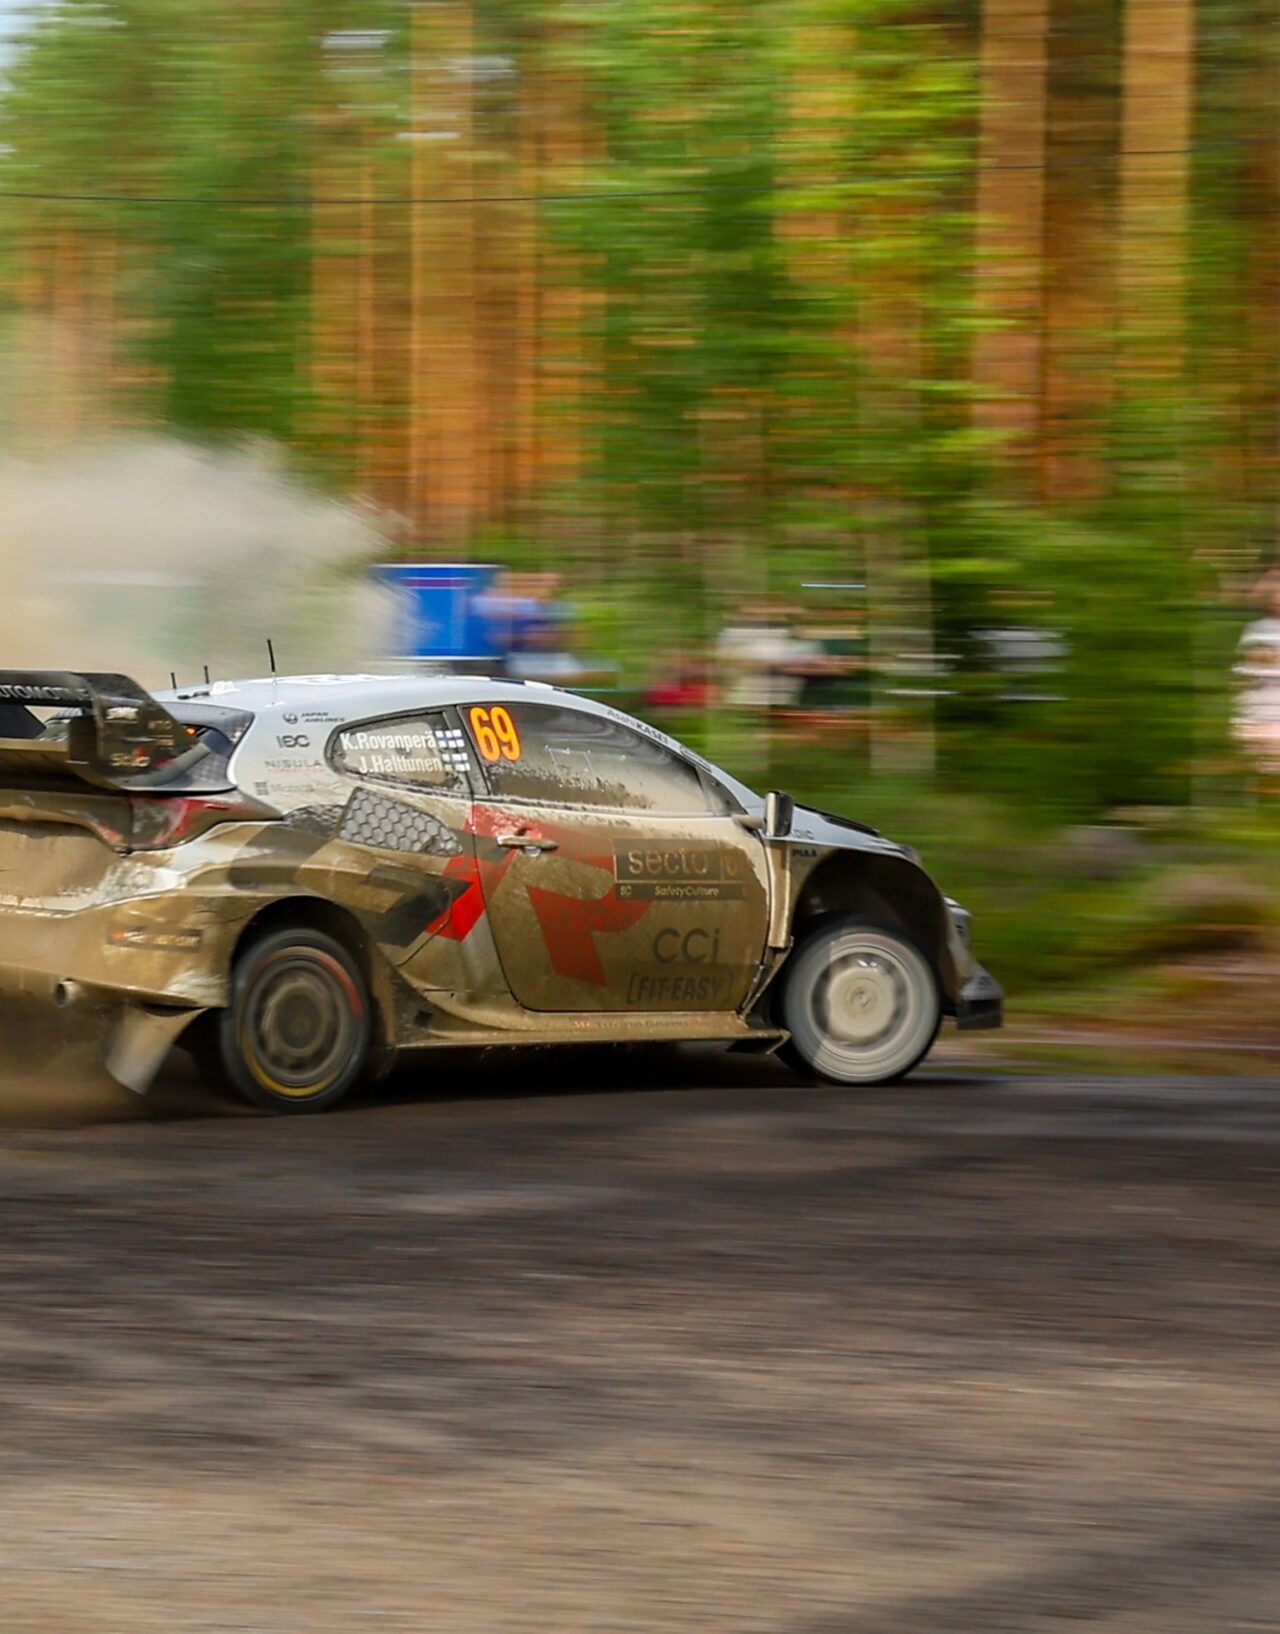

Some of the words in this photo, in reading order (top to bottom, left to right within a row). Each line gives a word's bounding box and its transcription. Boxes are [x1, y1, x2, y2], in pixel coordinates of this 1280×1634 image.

[340, 731, 437, 753] K.Rovanperä
[469, 706, 521, 762] 69
[359, 755, 442, 773] J.Halttunen
